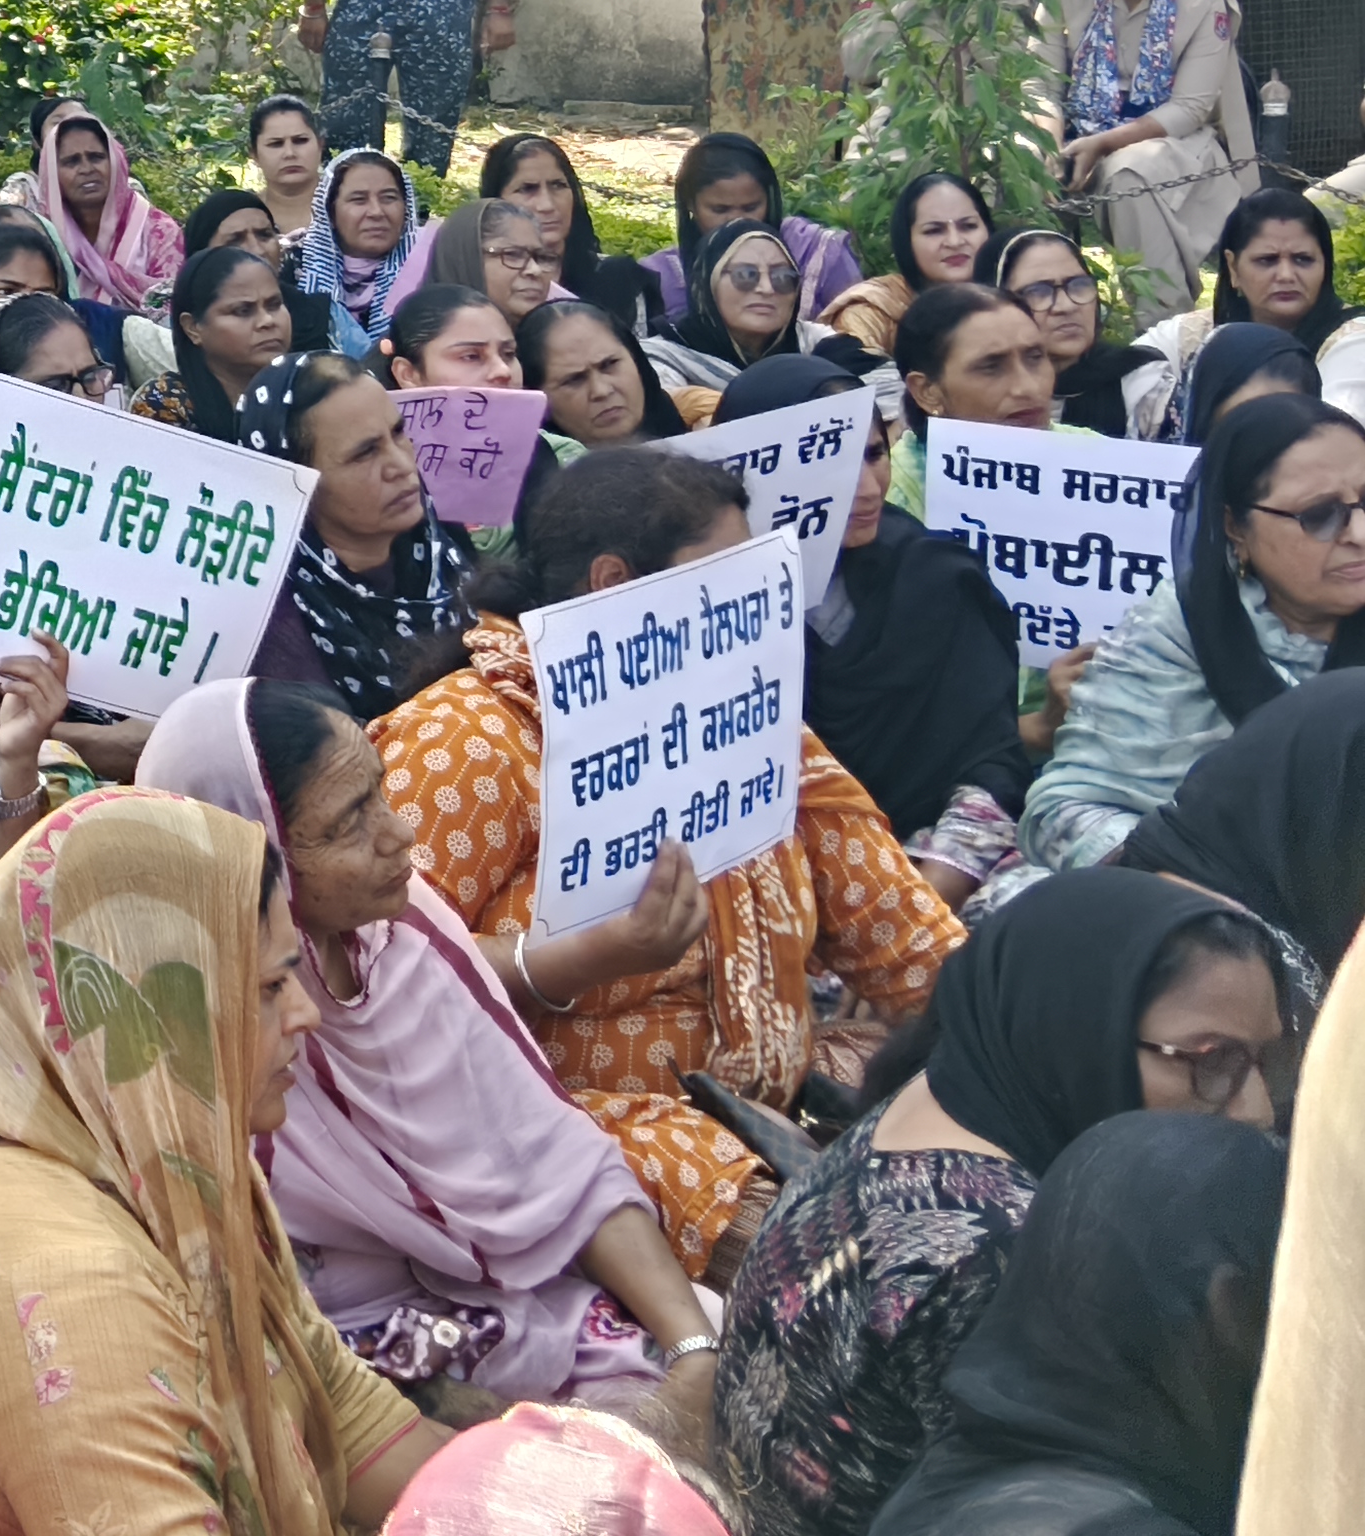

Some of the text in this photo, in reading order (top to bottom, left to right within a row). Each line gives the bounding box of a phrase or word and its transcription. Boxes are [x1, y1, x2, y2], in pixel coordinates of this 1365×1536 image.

[99, 465, 170, 554] ਵਿੱਚ
[941, 445, 1041, 495] ਪੰਜਾਬ
[120, 596, 189, 677] ਜਾਵੇ
[547, 630, 607, 715] ਖਾਲੀ
[700, 575, 770, 659] ਹੈਲਪਰਾਂ
[779, 562, 793, 629] ਤੇ
[571, 721, 649, 807] ਵਰਕਰਾਂ
[661, 701, 688, 770] ਦੀ
[560, 837, 591, 892] ਦੀ
[604, 807, 667, 877] ਭਰਤੀ
[680, 780, 729, 843] ਕੀਤੀ
